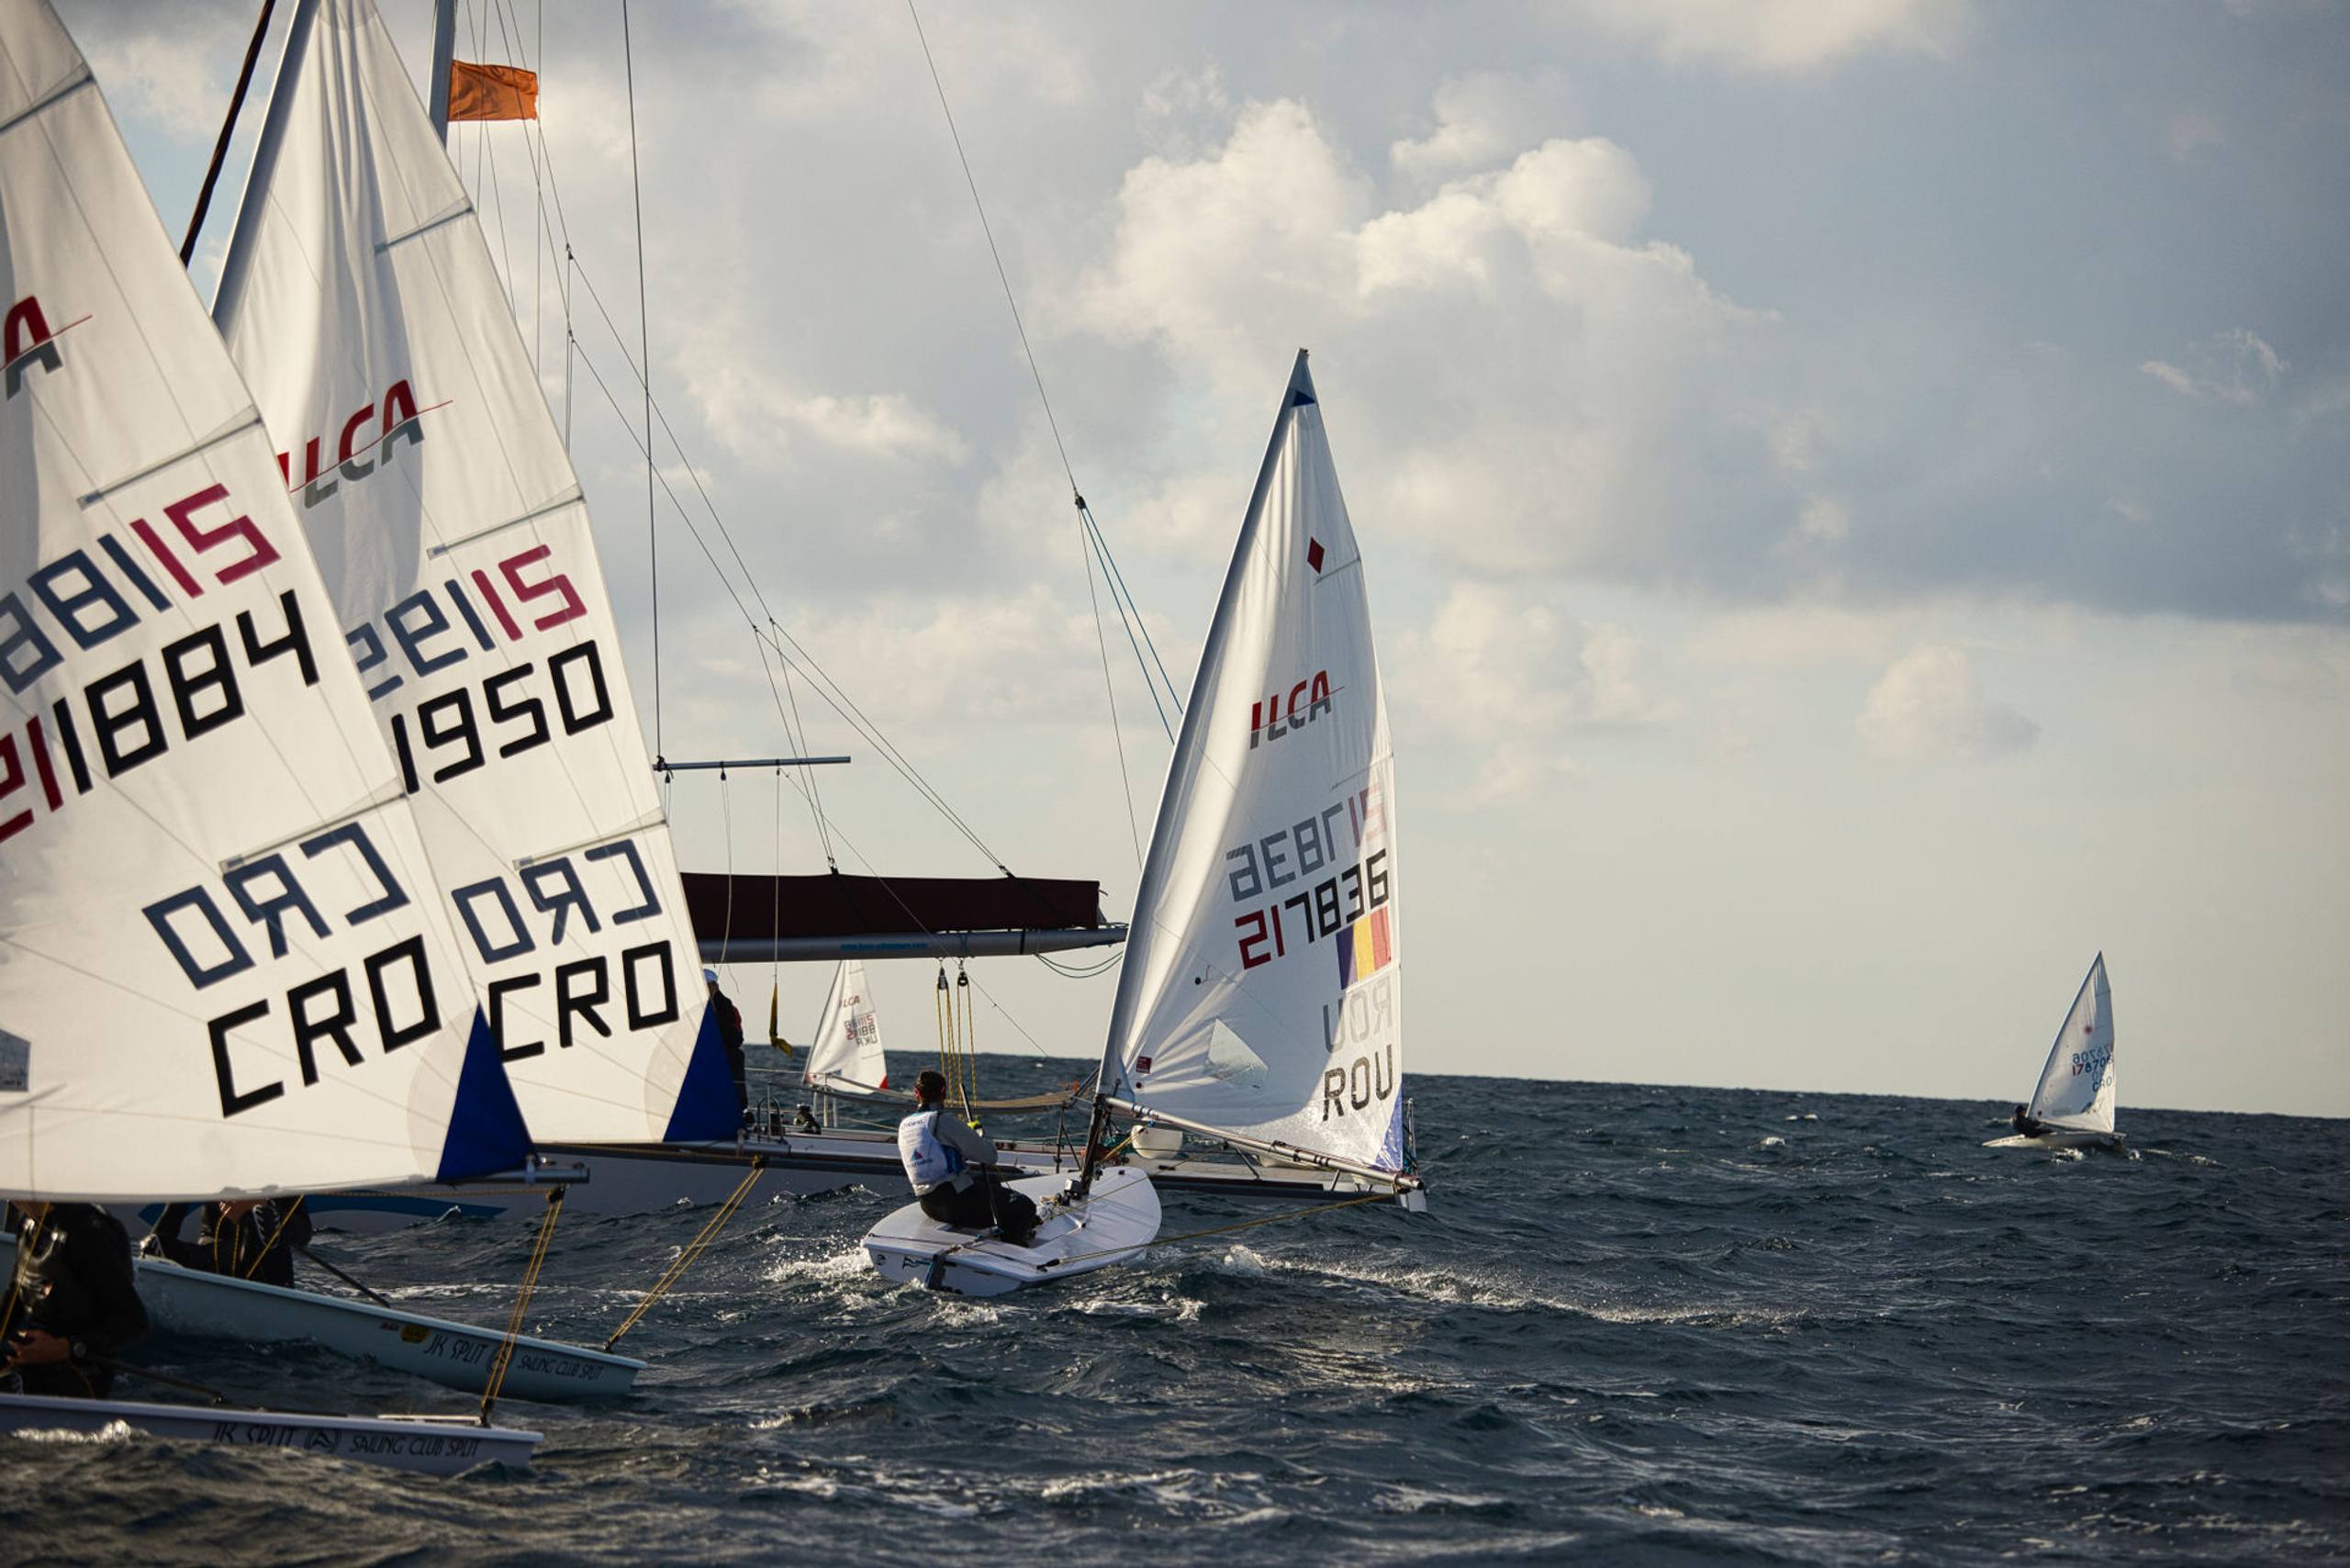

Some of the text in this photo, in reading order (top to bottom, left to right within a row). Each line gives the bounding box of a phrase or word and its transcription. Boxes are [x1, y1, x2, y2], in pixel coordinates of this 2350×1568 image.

[1250, 670, 1331, 749] ILCA
[1234, 848, 1389, 970] 217836
[207, 935, 442, 1118] CRO
[488, 940, 678, 1063] CRO
[1322, 1044, 1393, 1122] ROU
[2092, 1076, 2112, 1092] CRO
[423, 1334, 449, 1357] JK
[451, 1338, 487, 1365] SPLIT
[555, 1361, 580, 1378] CLUB
[578, 1365, 606, 1381] SPLIT
[350, 1434, 481, 1457] SAILING CLUB SPLIT
